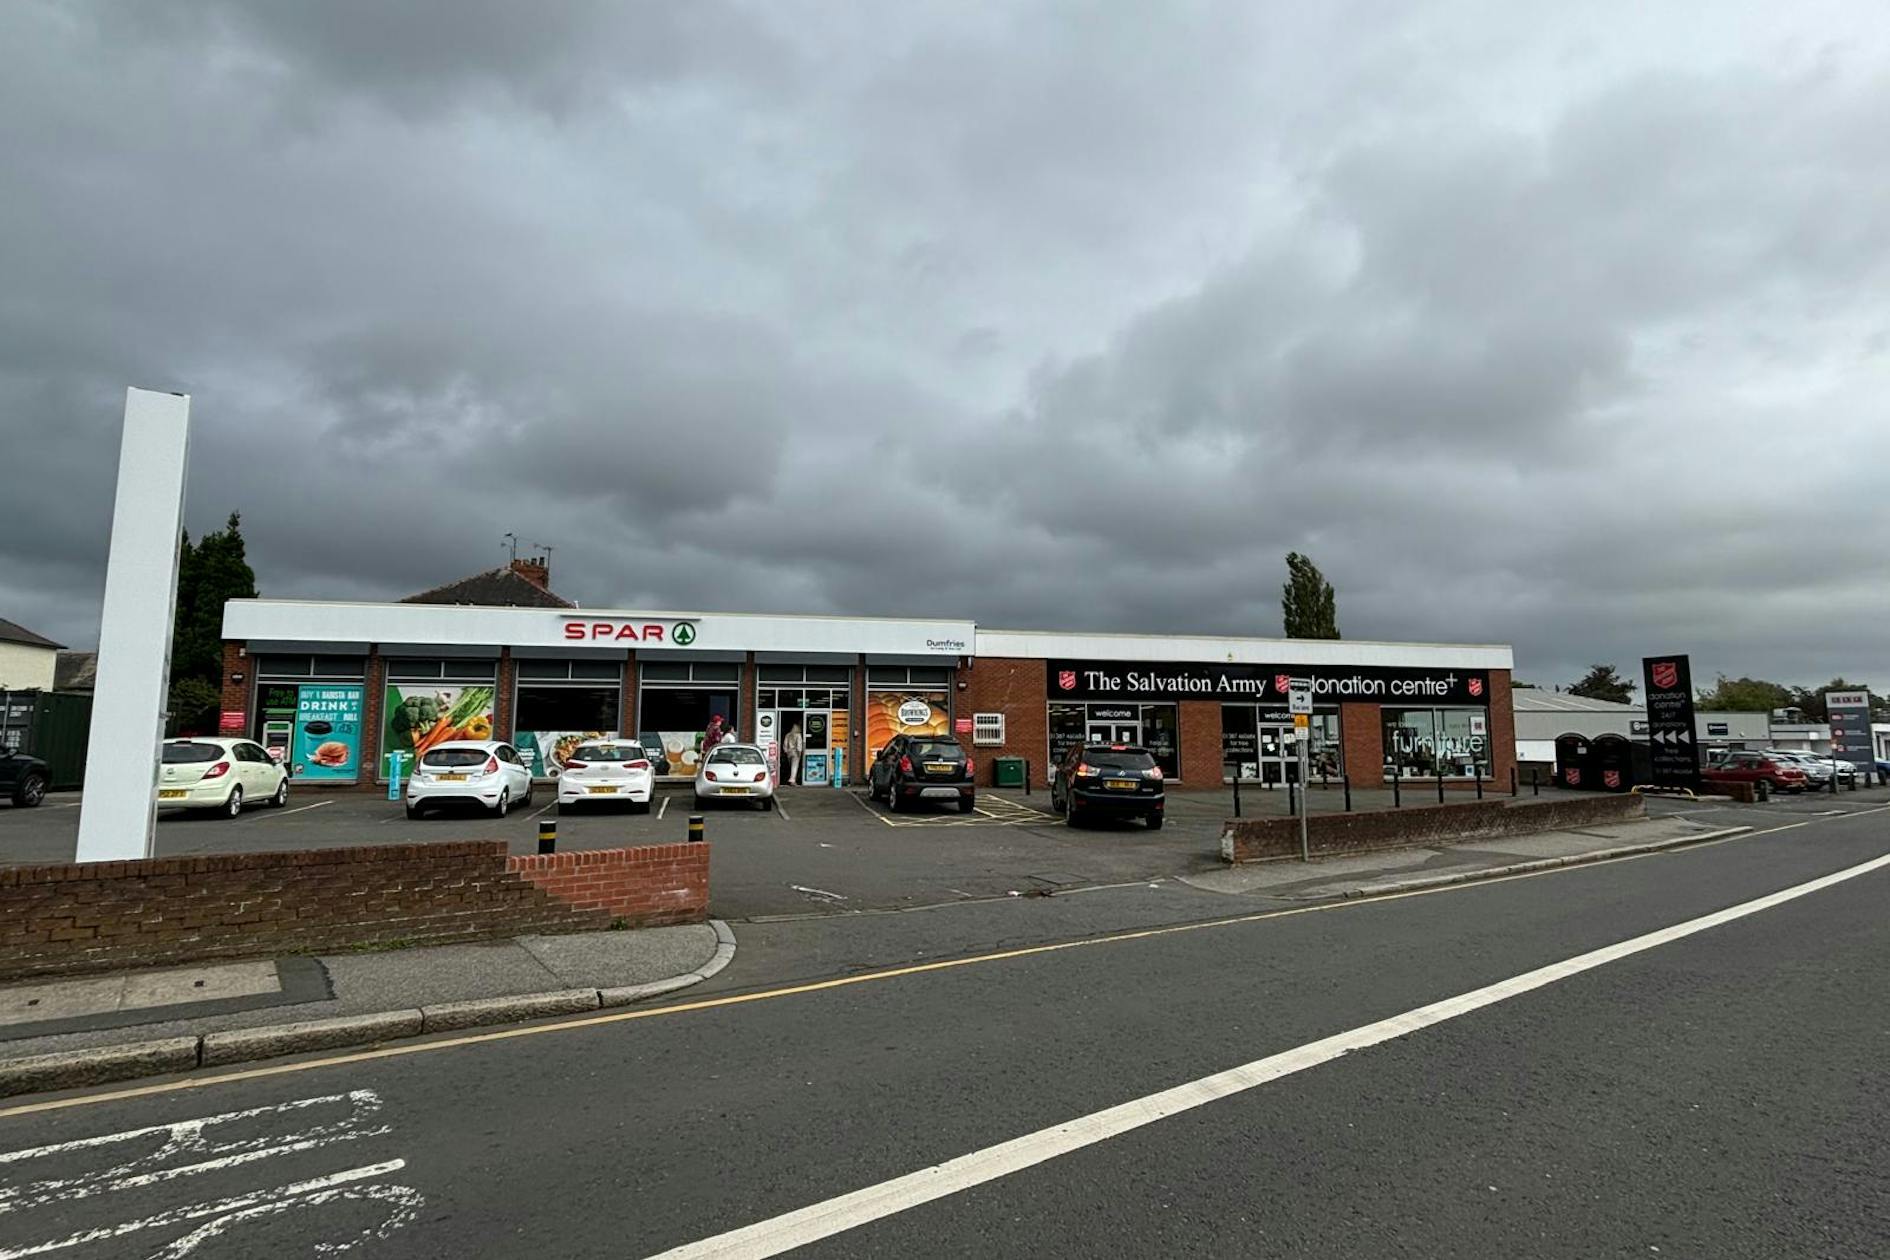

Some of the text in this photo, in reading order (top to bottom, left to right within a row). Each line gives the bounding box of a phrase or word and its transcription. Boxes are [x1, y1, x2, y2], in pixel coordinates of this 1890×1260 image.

[564, 623, 663, 642] SPAR
[926, 639, 965, 648] Dumfries
[1083, 671, 1121, 691] The
[1126, 672, 1212, 692] Salvation
[1215, 674, 1267, 698] Army
[1648, 692, 1686, 701] donation
[300, 701, 348, 711] DRINK
[1095, 709, 1132, 718] welcome
[1264, 711, 1294, 720] welcom
[1392, 730, 1484, 753] furniture
